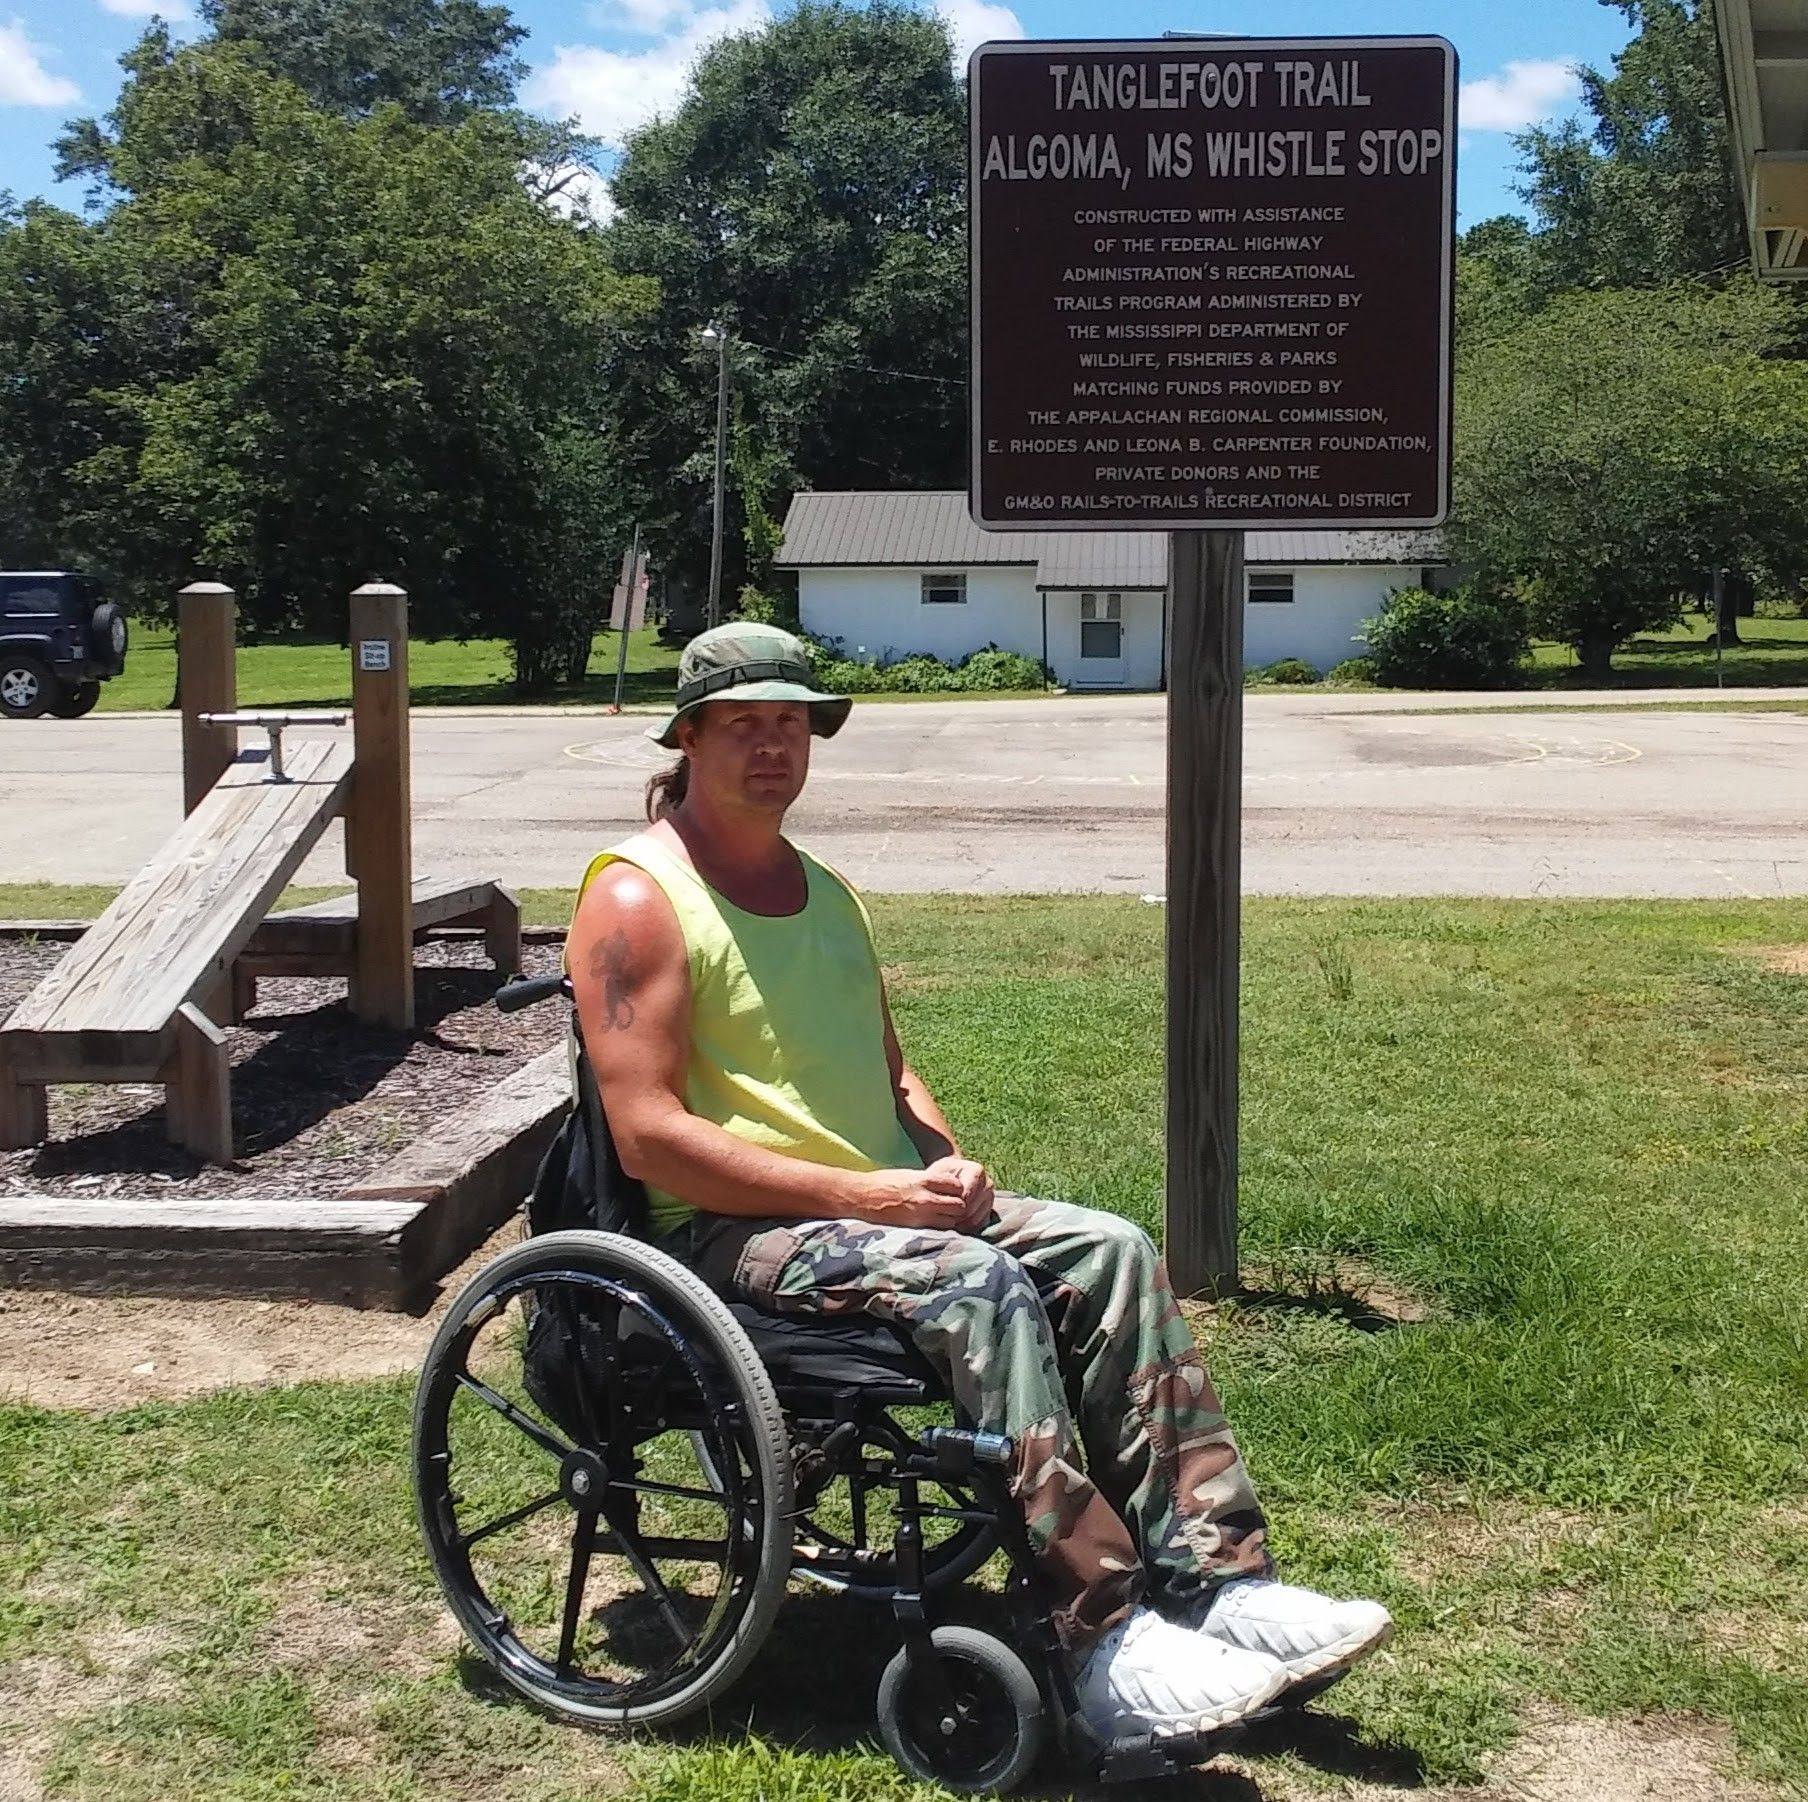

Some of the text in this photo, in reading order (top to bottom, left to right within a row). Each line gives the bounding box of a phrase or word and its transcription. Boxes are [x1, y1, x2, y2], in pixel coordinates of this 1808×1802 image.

[1049, 60, 1371, 110] TANGLEFOOT TRAIL
[982, 128, 1442, 191] ALGOMA, MS WHISTLE STOP
[1074, 207, 1345, 224] CONSTRUCTED WITH ASSISTANCE
[1094, 236, 1323, 252] OF THE FEDERAL HIGHWAY
[1062, 262, 1355, 281] ADMINISTRATION'S RECREATIONAL
[1054, 293, 1362, 311] TRAILS PROGRAM ADMINISTERED BY
[1067, 323, 1350, 339] THE MISSISSIPPI DEPARTMENT OF
[1079, 351, 1338, 370] WILDLIFE, FISHERIES & PARKS
[1073, 380, 1343, 396] MATCHING FUNDS PROVIDED BY
[1027, 408, 1389, 425] THE APPALACHAN REGIONAL COMMISSION,
[1010, 439, 1077, 453] RHODES
[1083, 438, 1120, 453] AND
[1126, 438, 1182, 453] LEONA
[1189, 437, 1206, 452] B.
[1212, 437, 1312, 451] CARPENTER
[1319, 436, 1432, 453] FOUNDATION,
[1095, 465, 1320, 481] PRIVATE DONORS AND THE
[1004, 493, 1412, 510] GM&O RAILS-TO-TRAILS RECREATIONAL DISTRICT
